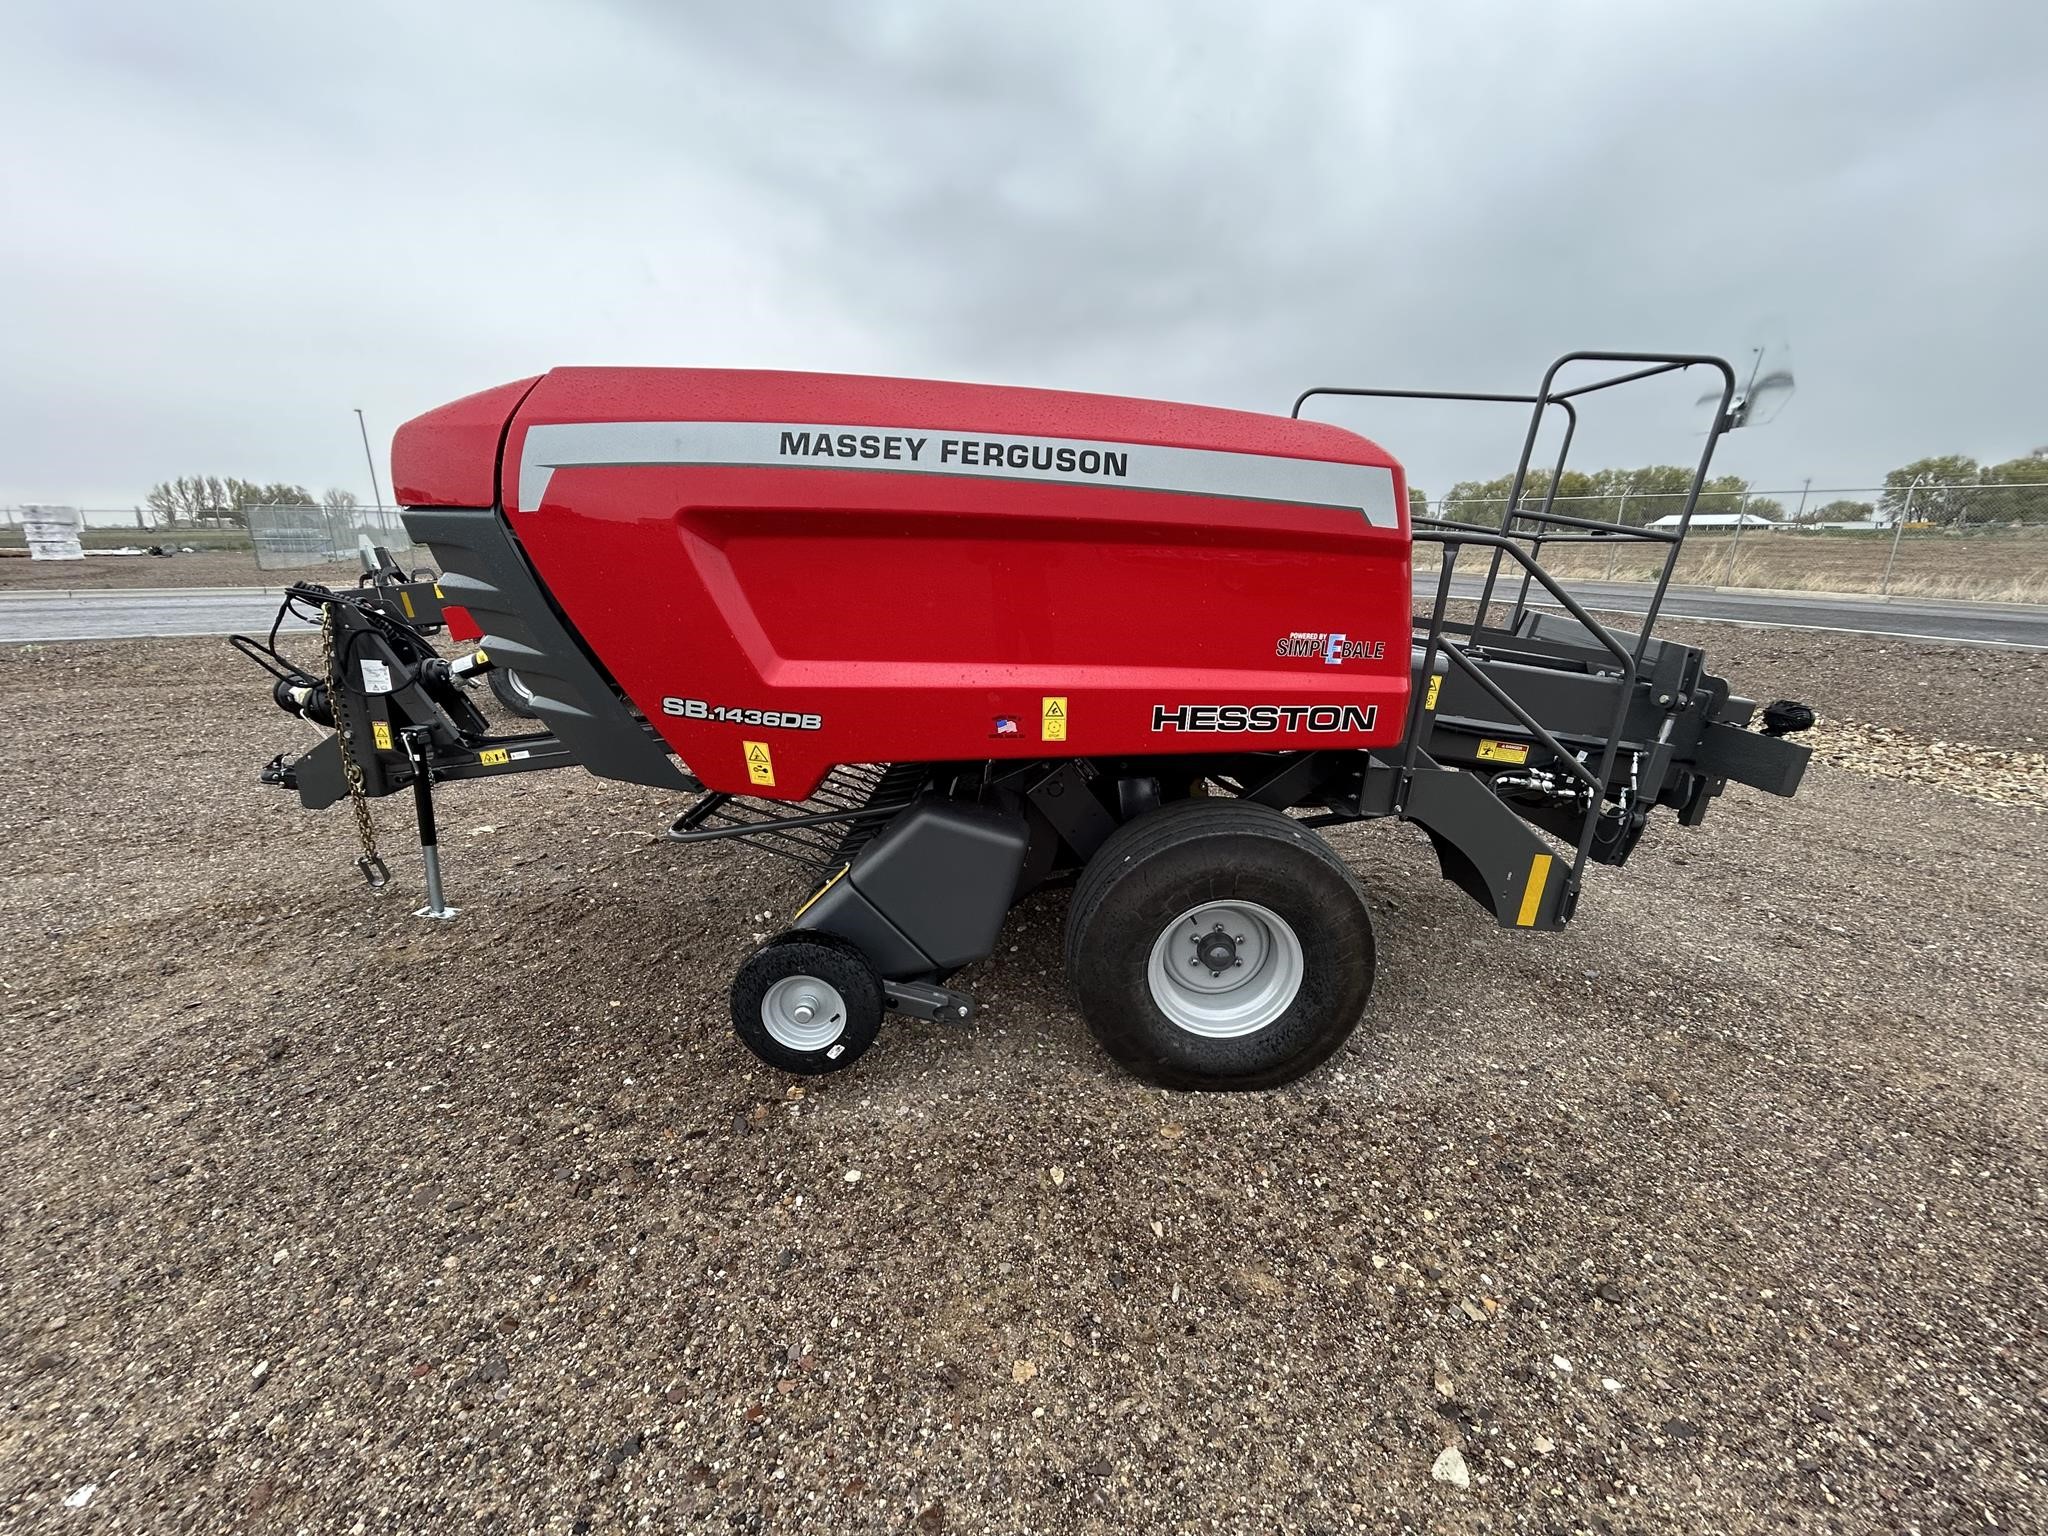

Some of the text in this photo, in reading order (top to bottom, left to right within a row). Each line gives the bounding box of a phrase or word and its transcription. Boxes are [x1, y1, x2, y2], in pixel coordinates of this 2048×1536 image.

[779, 431, 1128, 477] MASSEY FERGUSON
[1290, 632, 1327, 640] POWERED BY
[662, 697, 822, 730] SB.1436DB
[1151, 705, 1378, 733] HESSTON
